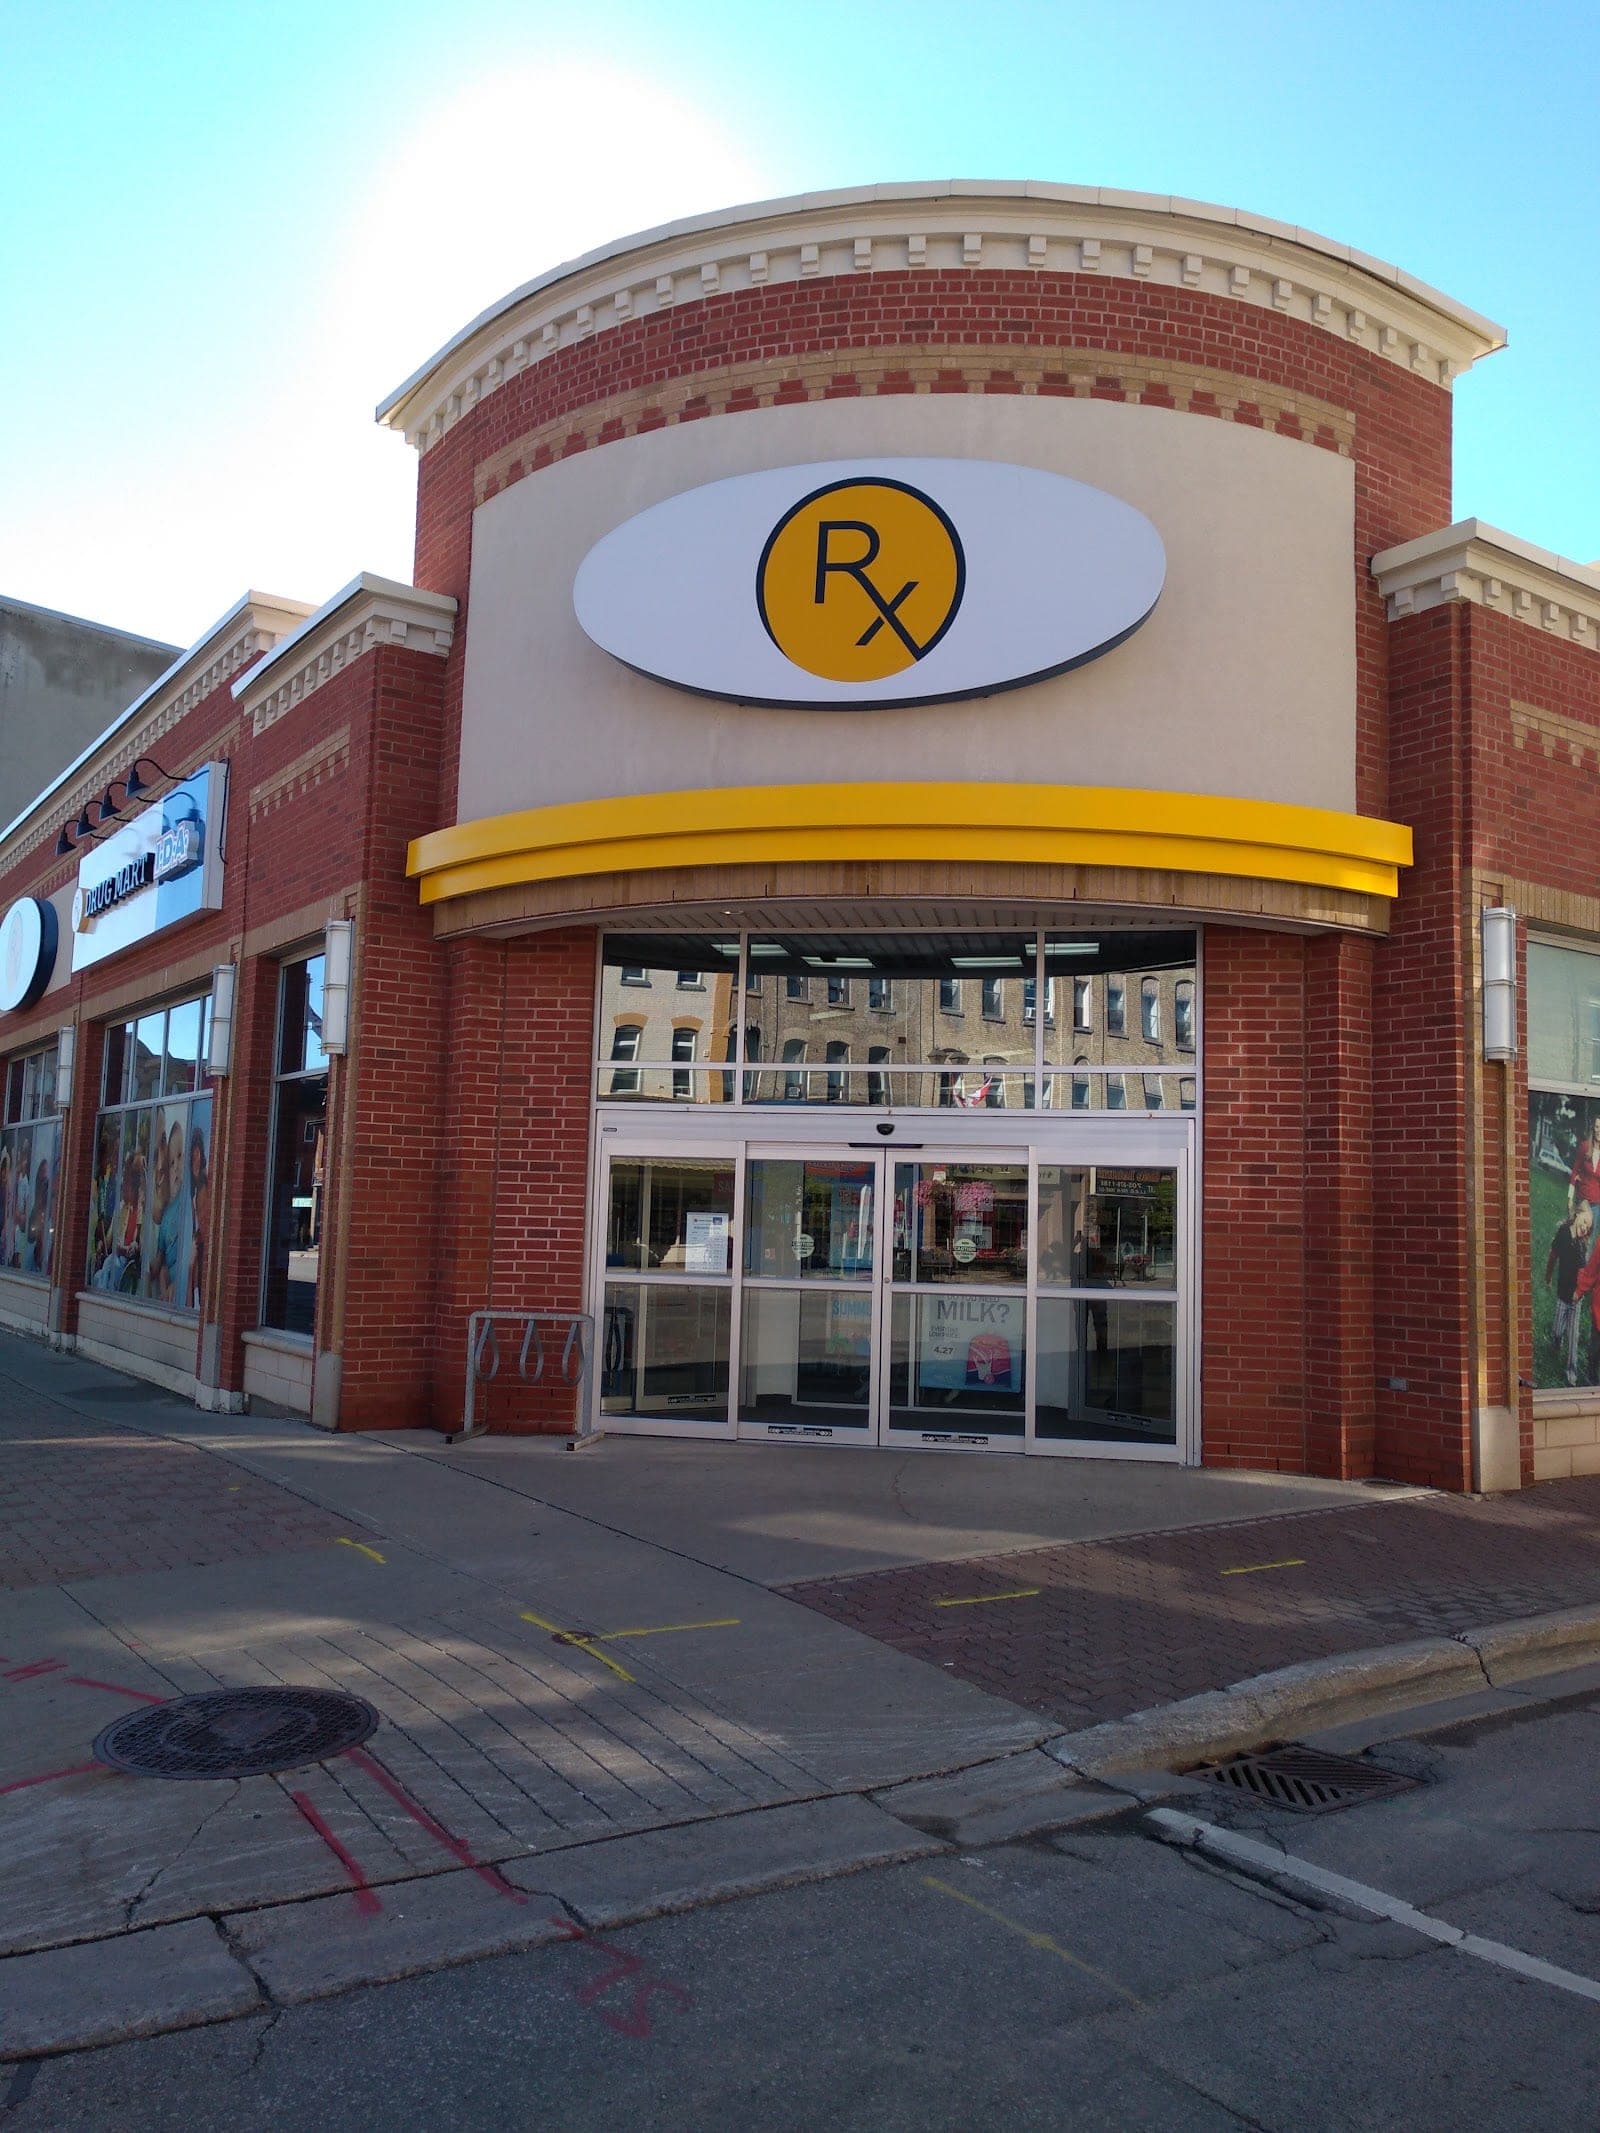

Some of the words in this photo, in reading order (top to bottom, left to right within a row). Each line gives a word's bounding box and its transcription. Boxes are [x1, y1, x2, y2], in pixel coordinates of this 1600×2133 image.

[85, 877, 117, 917] DRUG
[114, 852, 155, 900] MART
[937, 1300, 1010, 1323] MILK?
